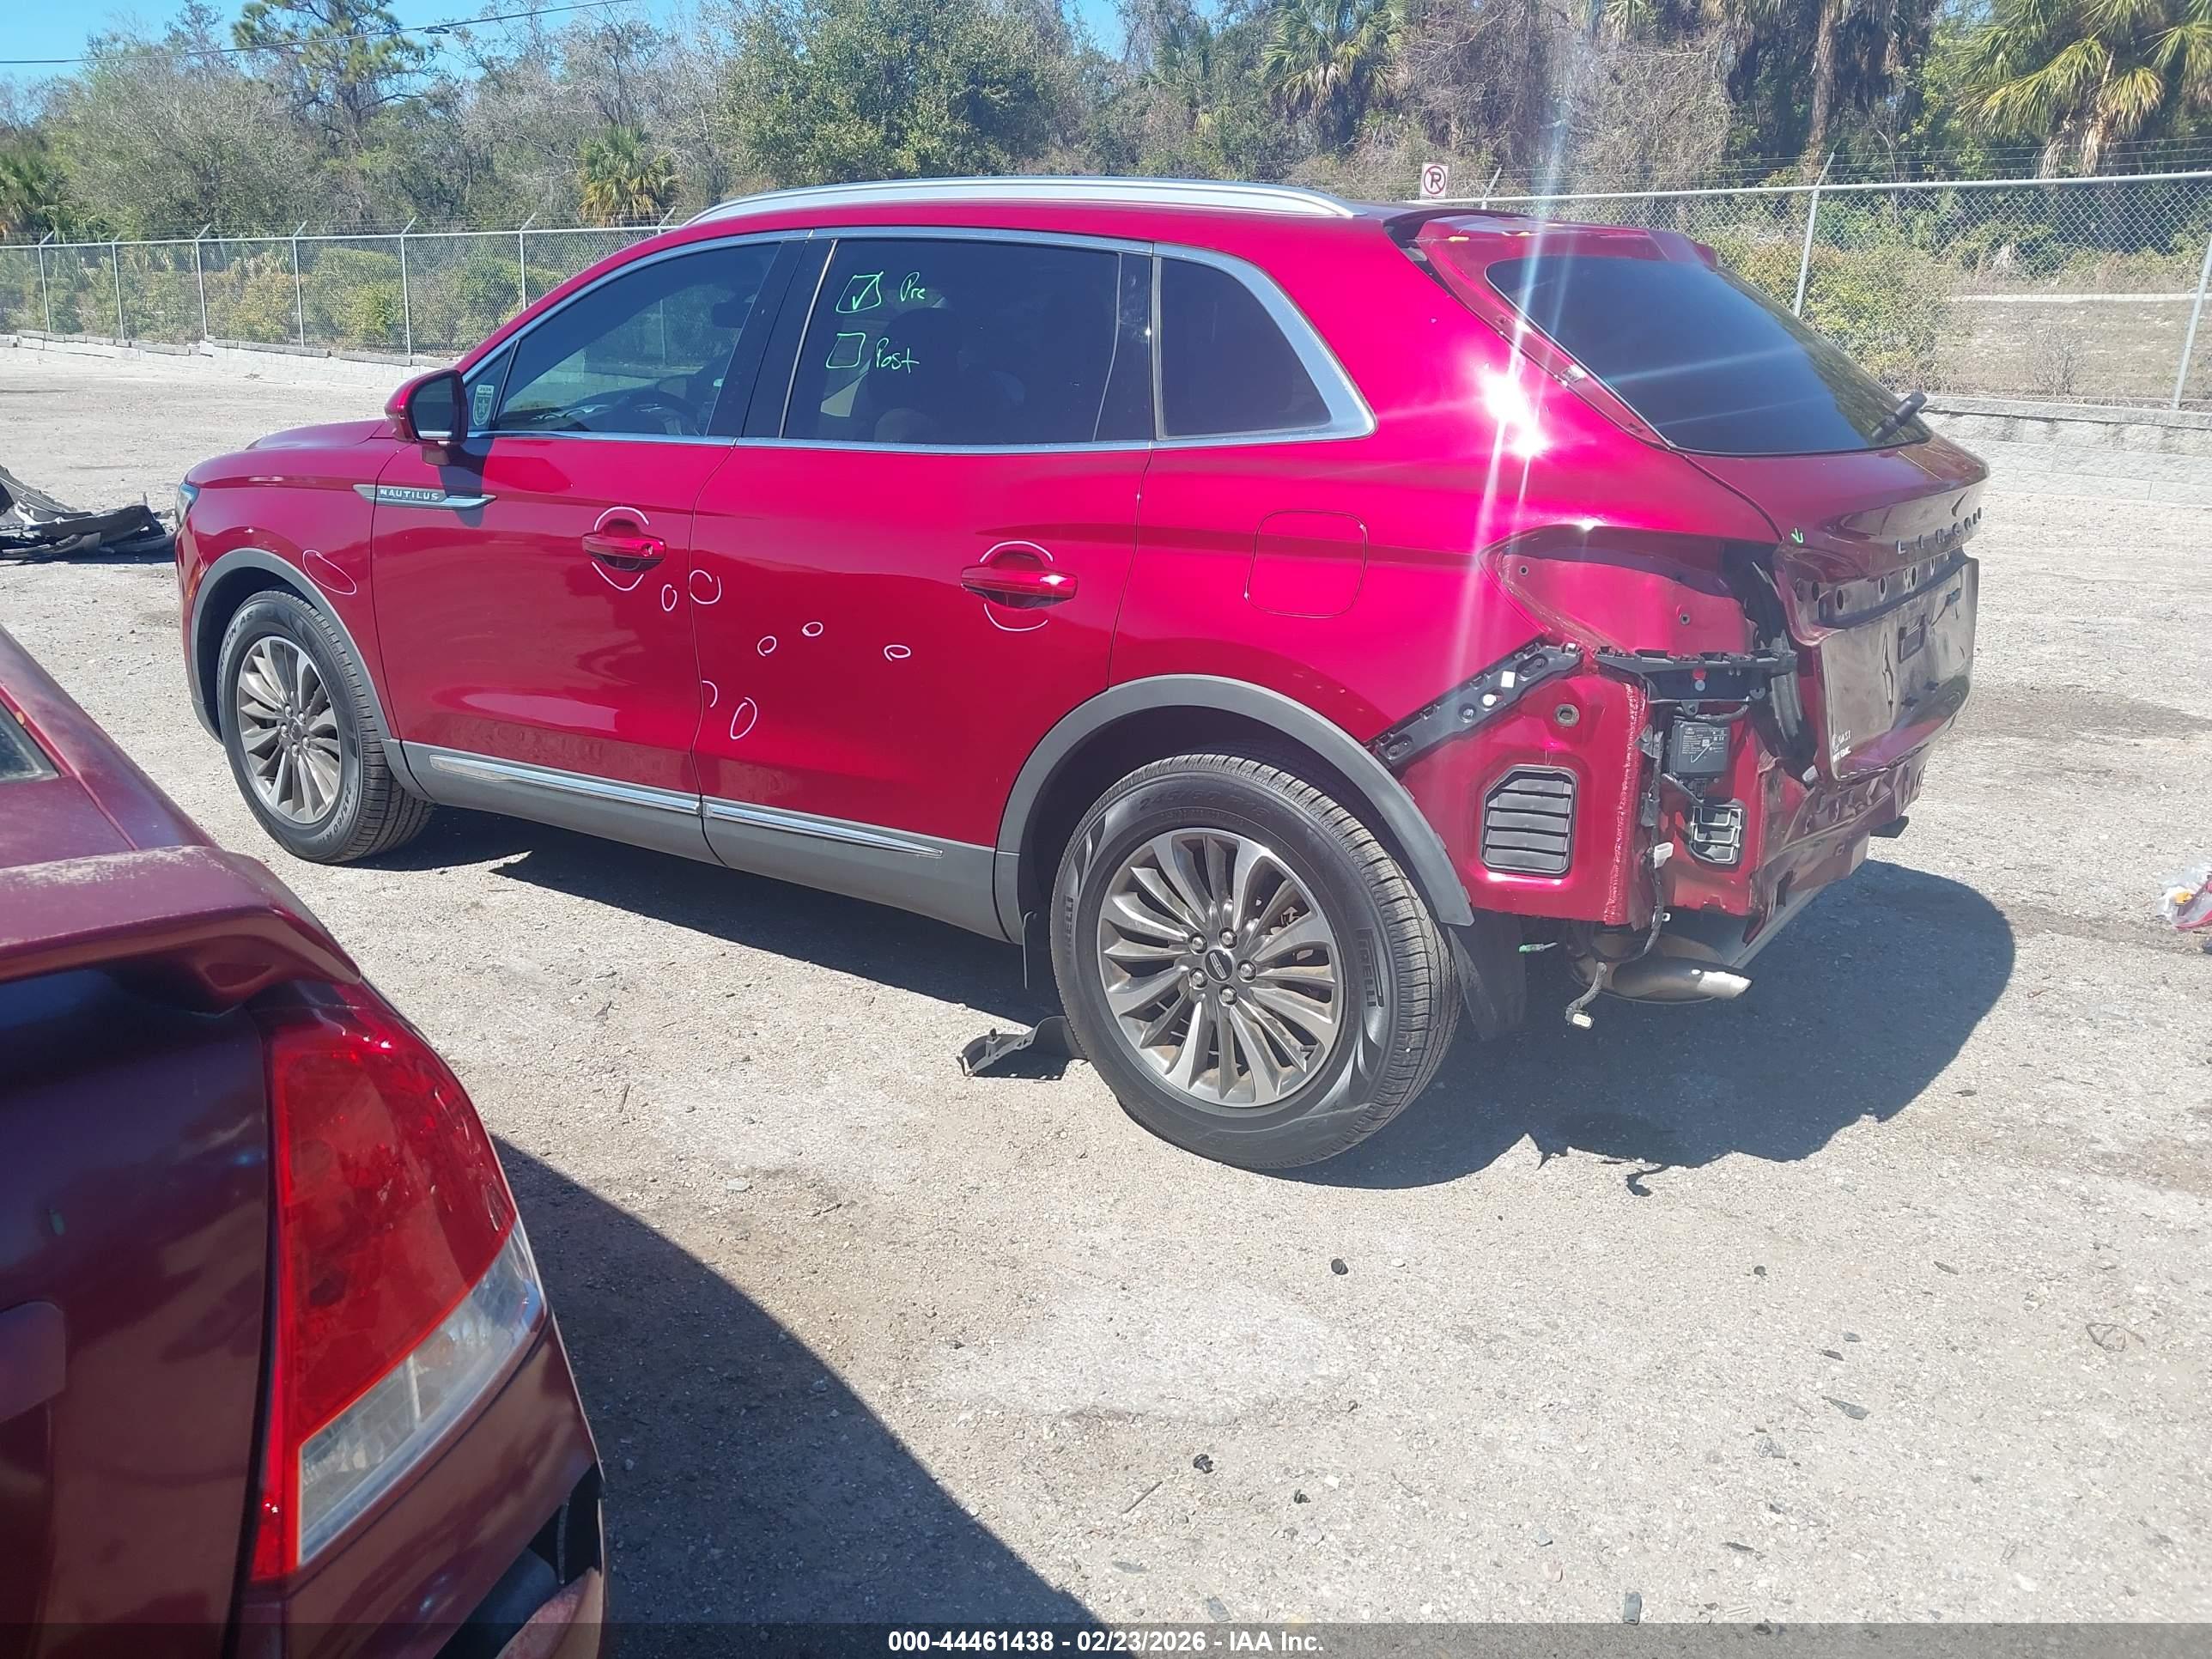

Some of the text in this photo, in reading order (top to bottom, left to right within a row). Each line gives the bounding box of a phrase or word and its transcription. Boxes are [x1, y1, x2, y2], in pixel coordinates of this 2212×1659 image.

[900, 271, 927, 302] Pre
[876, 337, 921, 374] Post
[380, 489, 440, 501] NAUTILUS
